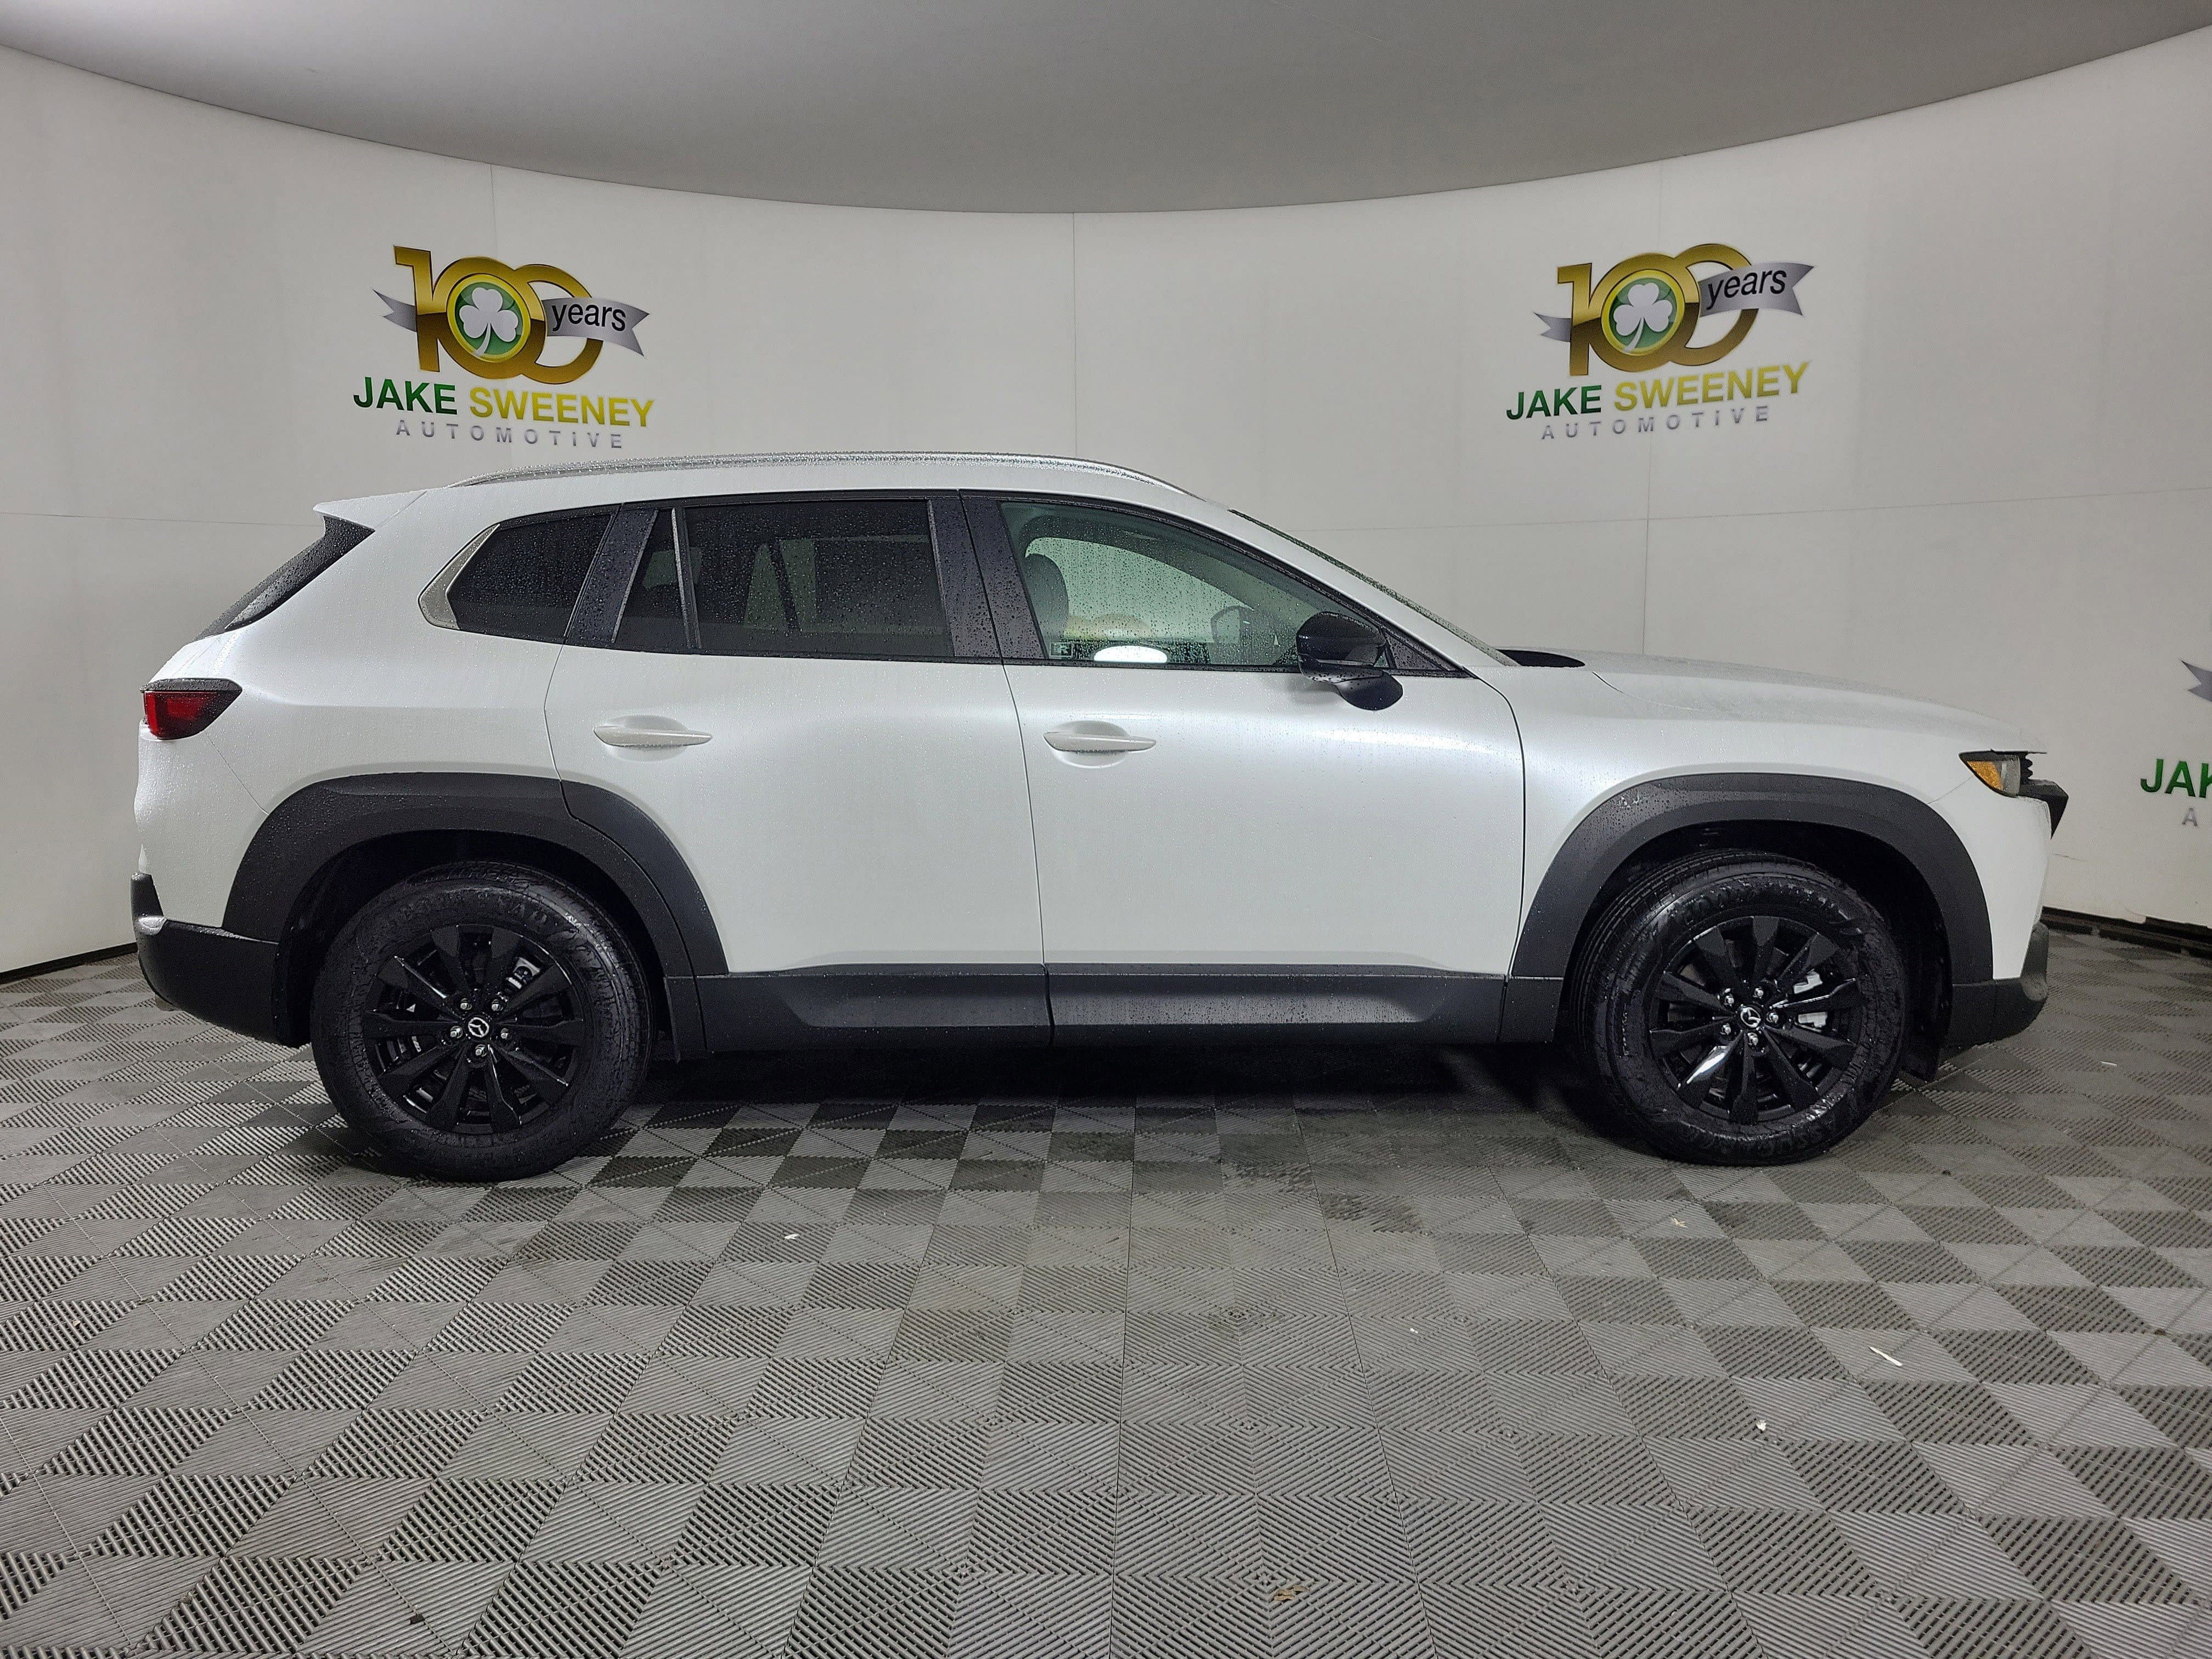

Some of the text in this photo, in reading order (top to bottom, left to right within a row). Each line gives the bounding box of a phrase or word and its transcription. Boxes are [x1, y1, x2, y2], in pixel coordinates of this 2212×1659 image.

[393, 245, 627, 385] 100 years
[1557, 243, 1787, 376] 100 years
[353, 376, 654, 427] JAKE SWEENEY
[1506, 361, 1810, 420] JAKE SWEENEY
[396, 419, 623, 449] AUTOMOTIVE
[1542, 405, 1769, 440] AUTOMOTIVE
